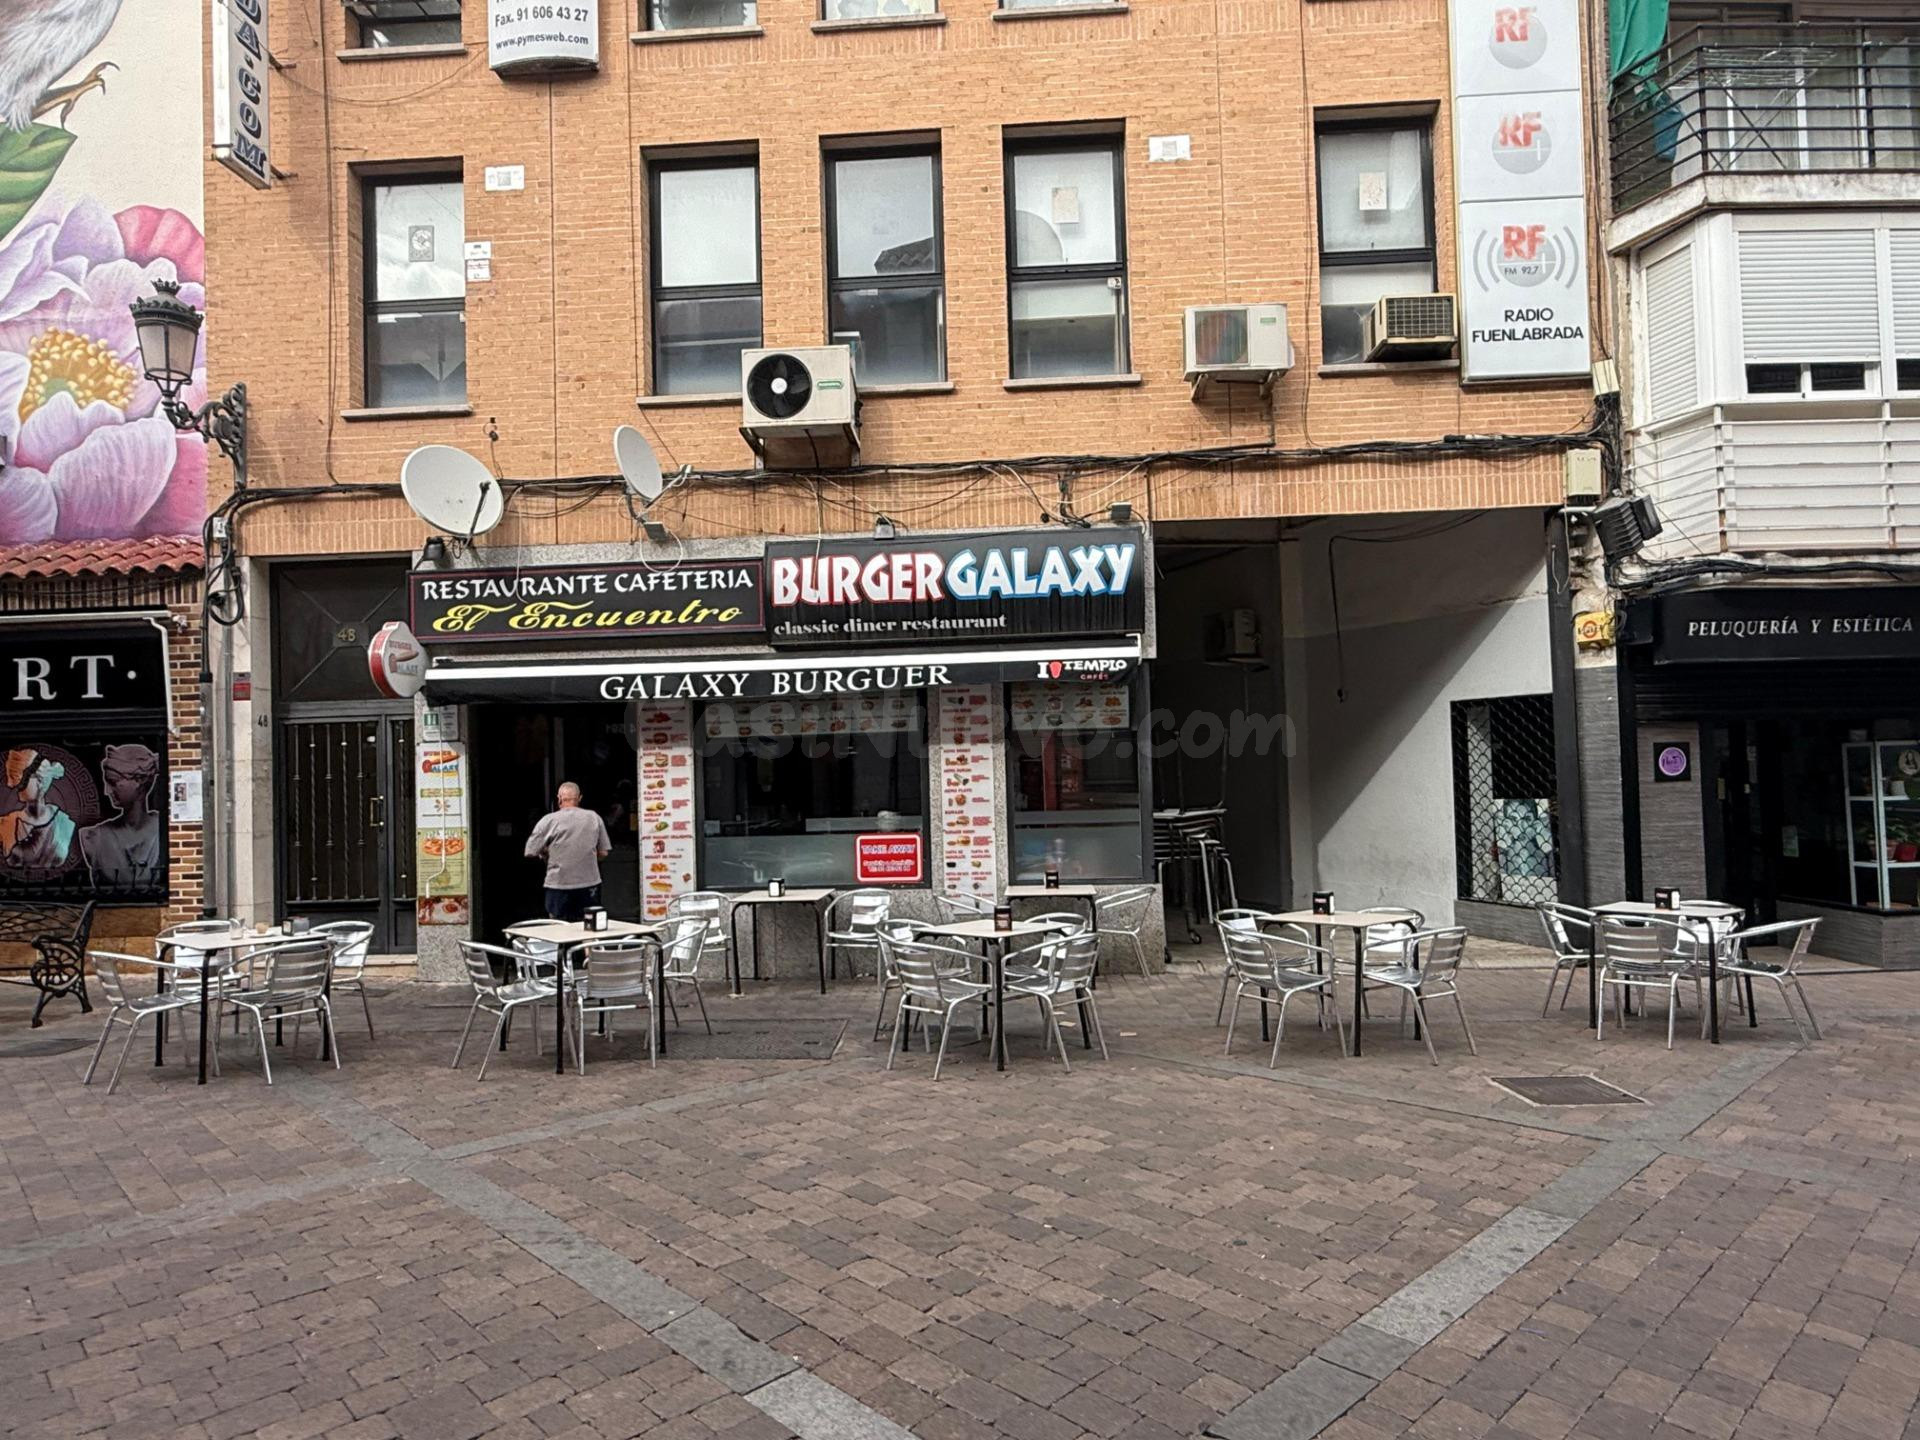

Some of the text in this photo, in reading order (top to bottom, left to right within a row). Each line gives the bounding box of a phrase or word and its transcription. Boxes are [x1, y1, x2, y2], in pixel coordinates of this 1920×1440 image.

[495, 6, 588, 27] Fax. 91 606 43 27
[1495, 6, 1537, 43] RF
[496, 32, 589, 49] www.pymesweb.com
[1500, 111, 1542, 147] RF
[1502, 224, 1545, 260] RF
[1504, 267, 1517, 275] FM
[1504, 307, 1554, 322] RADIO
[1472, 326, 1584, 343] FUENLABRADA
[421, 568, 754, 600] RESTAURANTE CAFETERIA
[771, 543, 1135, 607] BURGER GALAXY
[432, 599, 743, 632] El Encuentro
[774, 613, 1007, 636] classic diner restaurant
[1688, 614, 1914, 638] PELUQUERÍA Y ESTÉTICA
[337, 628, 356, 642] 48
[600, 665, 952, 700] GALAXY BURGUER
[257, 714, 268, 728] 48
